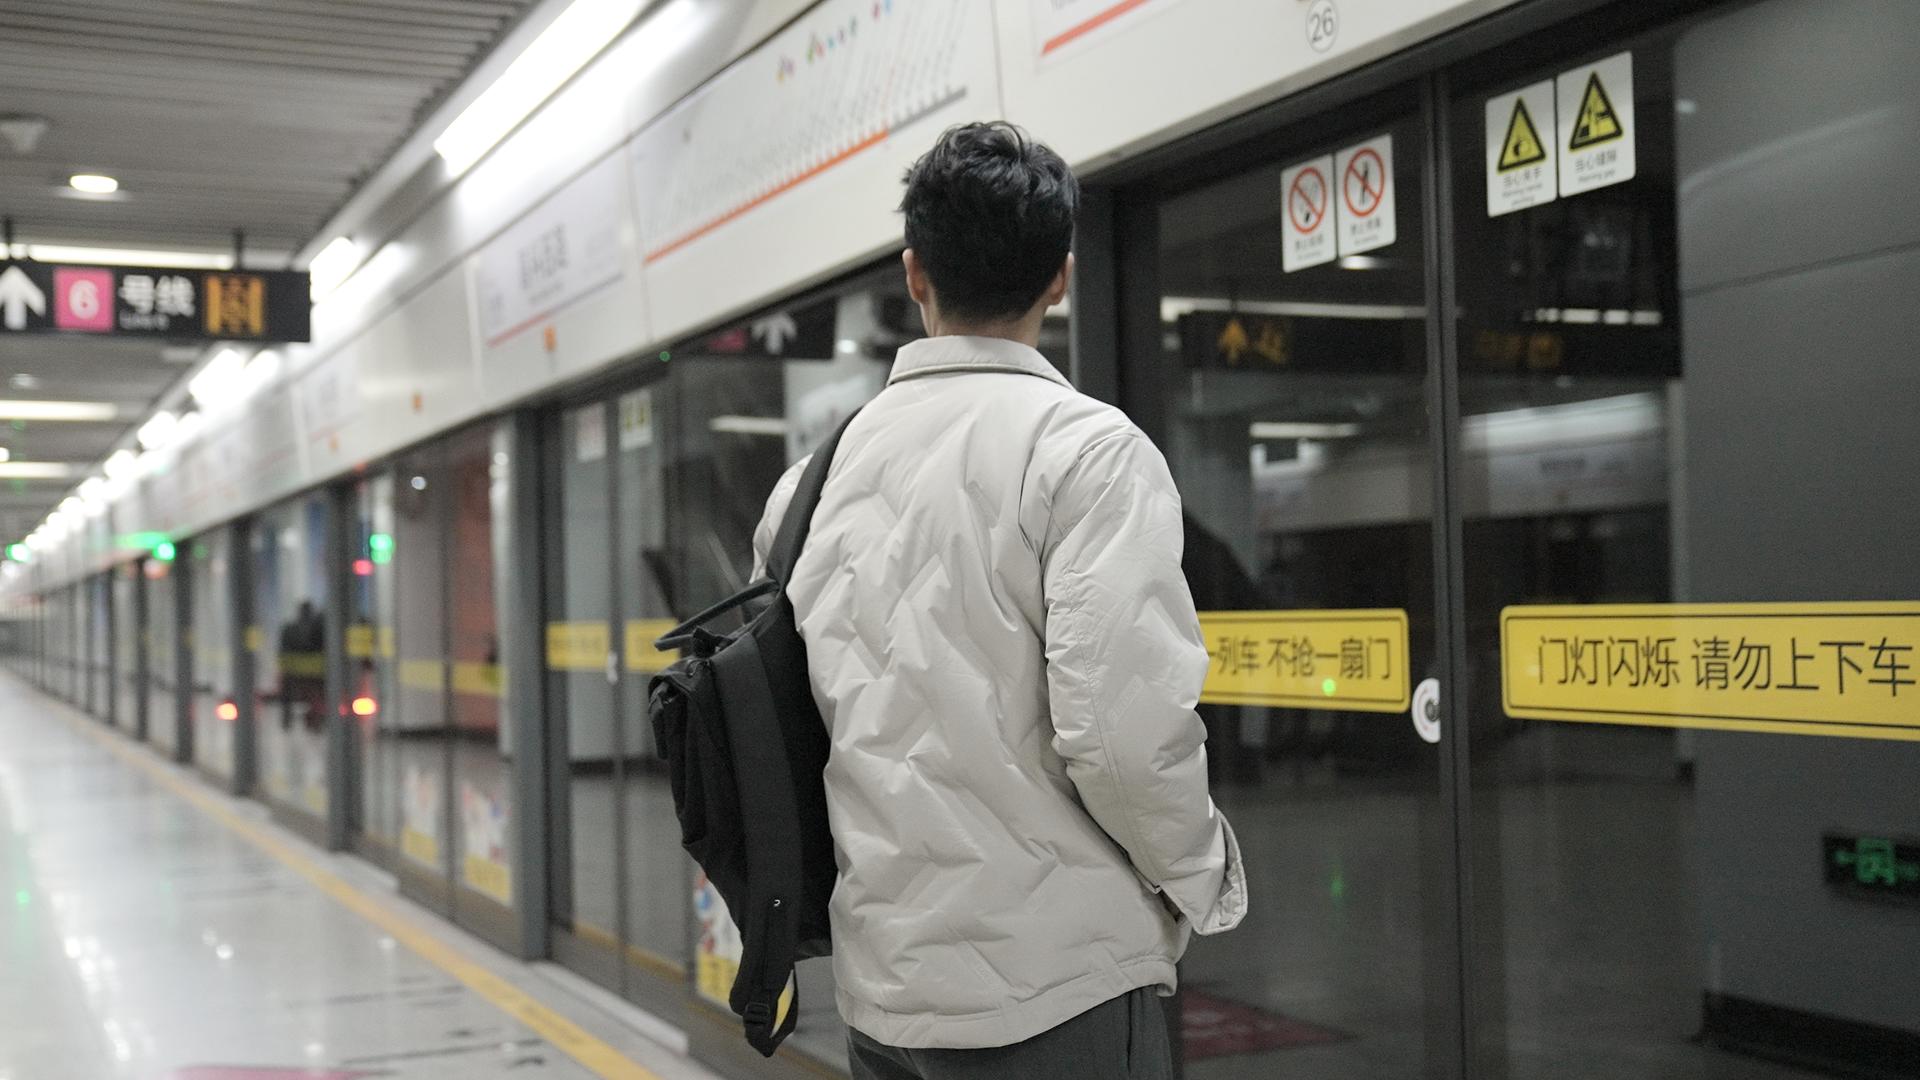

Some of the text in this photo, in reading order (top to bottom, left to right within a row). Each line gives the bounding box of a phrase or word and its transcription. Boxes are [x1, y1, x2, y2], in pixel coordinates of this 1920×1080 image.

[1309, 6, 1334, 44] 26
[68, 273, 196, 320] 6 号线
[1267, 635, 1391, 680] 不抢一扇门
[1538, 635, 1917, 698] 门灯闪烁 请勿上下车
